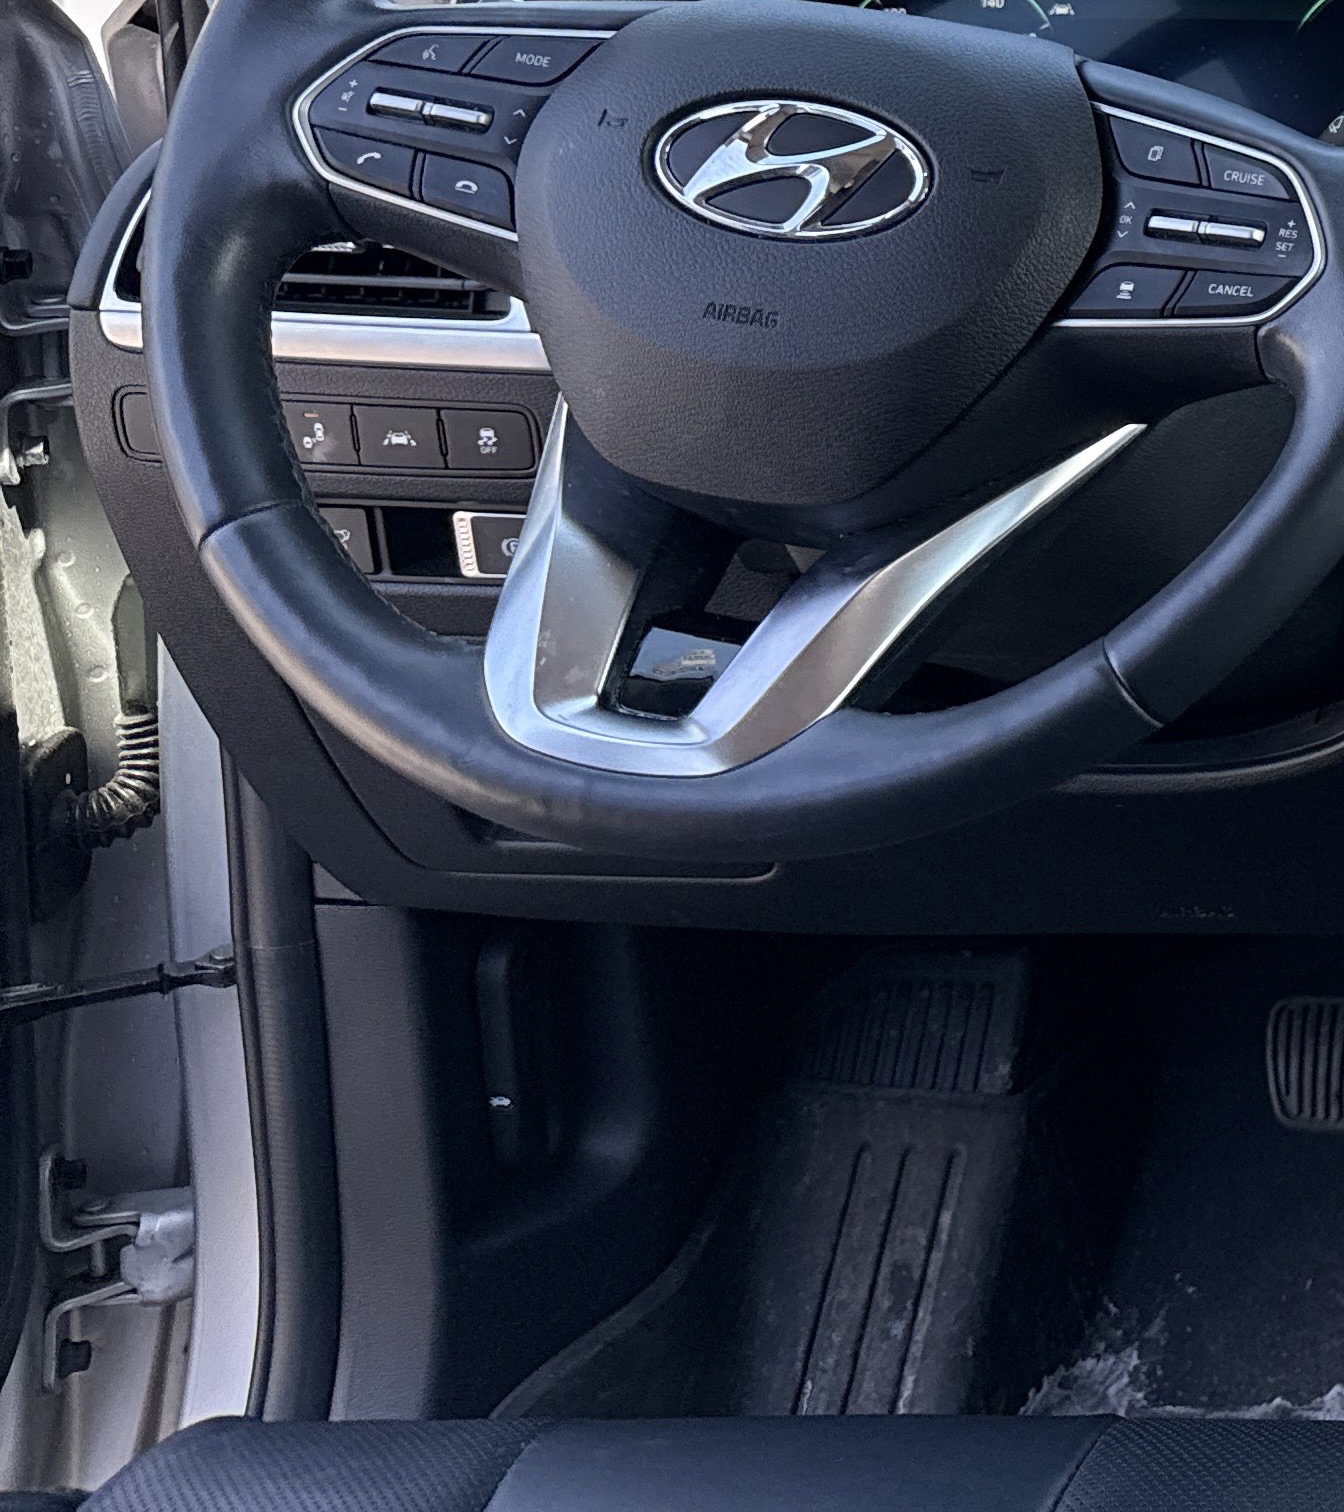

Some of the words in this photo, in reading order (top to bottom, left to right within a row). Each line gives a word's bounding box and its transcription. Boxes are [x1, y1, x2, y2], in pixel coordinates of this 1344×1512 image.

[515, 51, 552, 68] MODE
[1223, 169, 1266, 186] CRUISE
[1119, 214, 1132, 225] OK
[1278, 228, 1299, 239] RES
[1275, 241, 1296, 253] SET
[1208, 283, 1254, 298] CANCEL
[702, 301, 779, 328] AIRBAG
